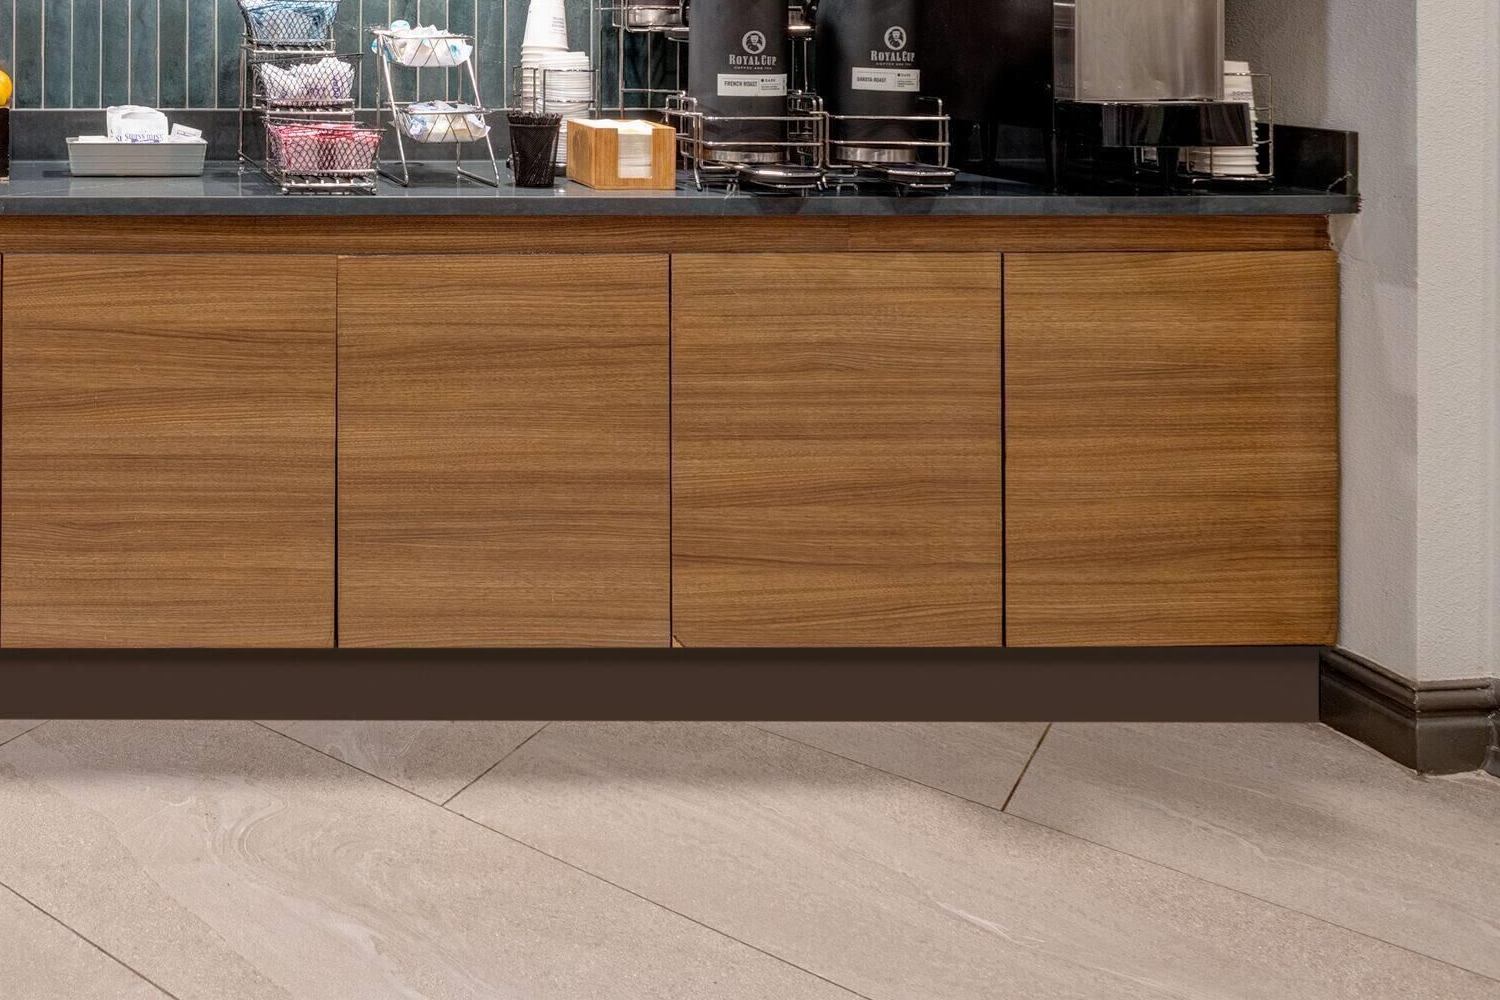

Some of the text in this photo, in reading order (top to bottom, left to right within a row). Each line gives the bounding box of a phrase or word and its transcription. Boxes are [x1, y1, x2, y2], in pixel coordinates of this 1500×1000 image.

[729, 54, 777, 66] ROYAL CUP
[869, 50, 916, 62] ROYAL CUP
